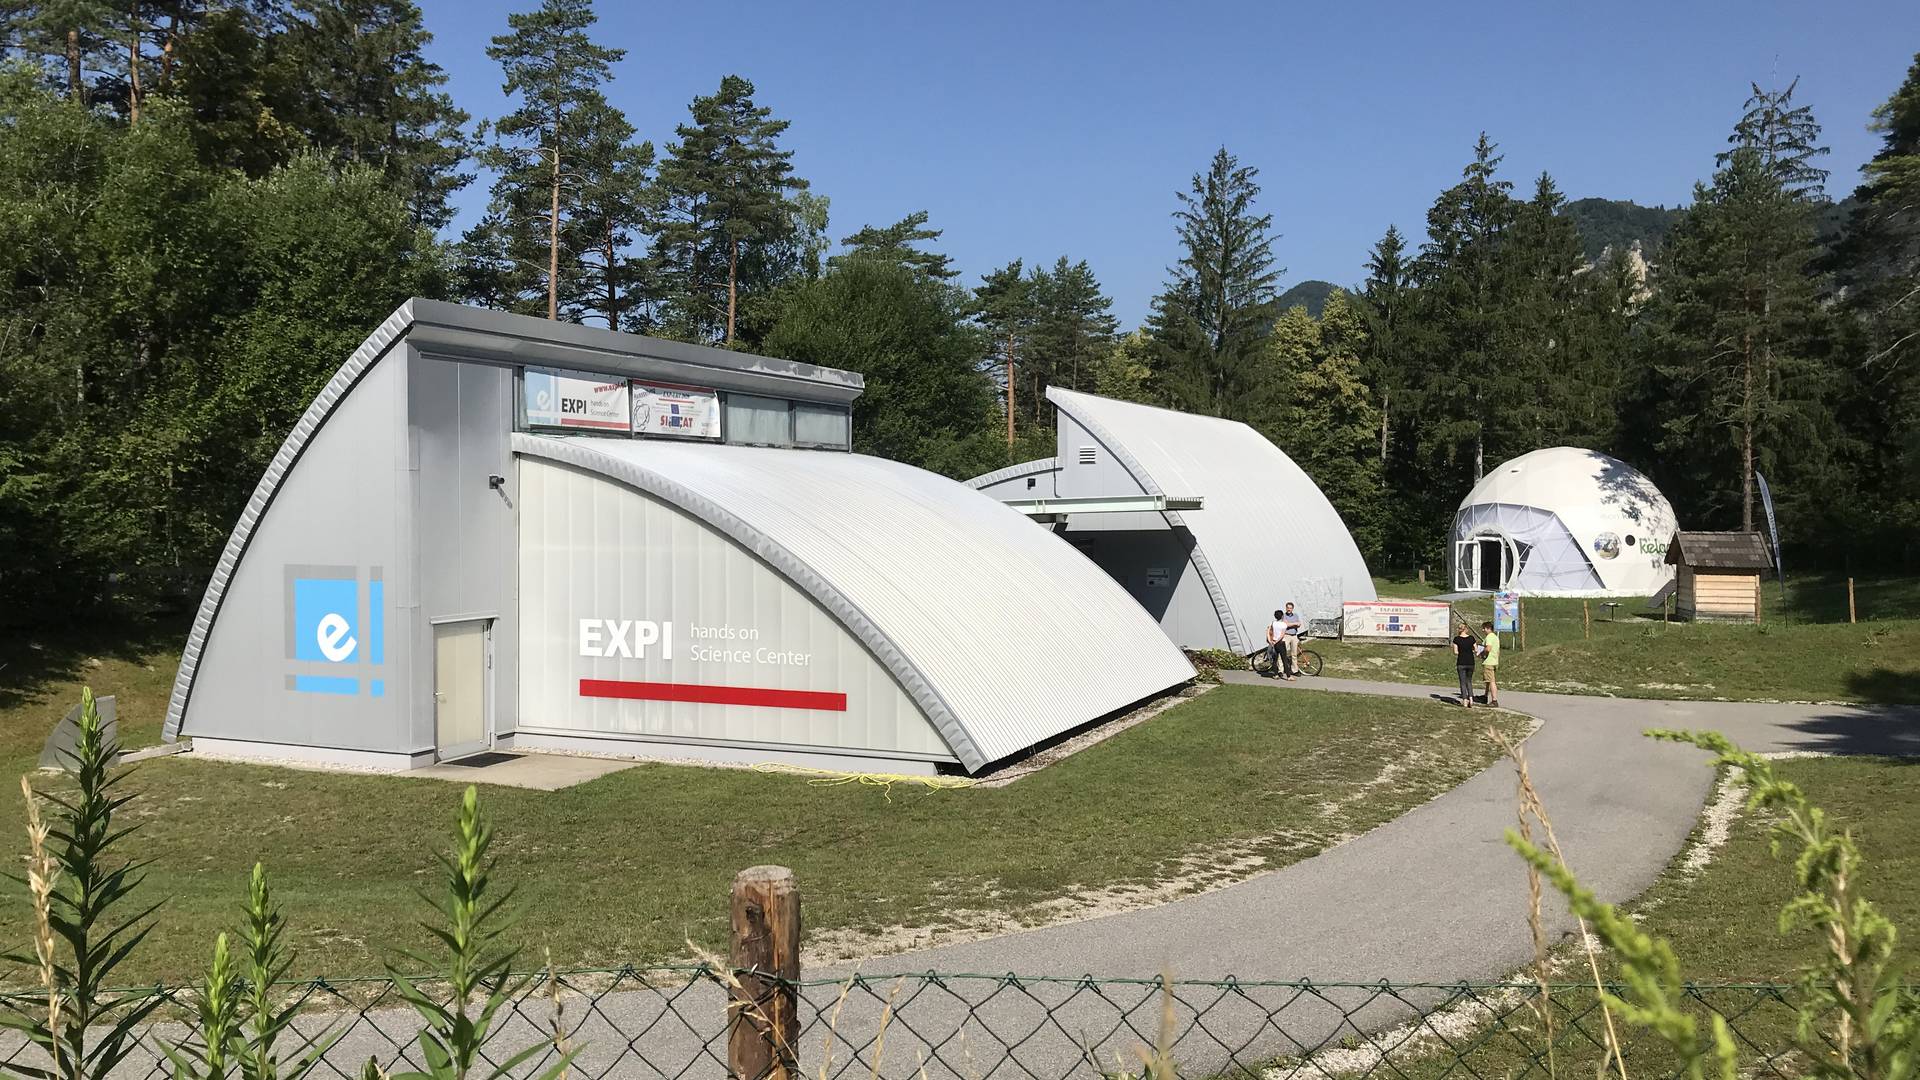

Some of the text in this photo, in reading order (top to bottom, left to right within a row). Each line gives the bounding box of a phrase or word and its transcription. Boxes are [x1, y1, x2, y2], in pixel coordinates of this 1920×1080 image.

[561, 398, 587, 414] EXPI
[1639, 538, 1671, 554] kela
[579, 618, 673, 660] EXPI
[690, 623, 759, 640] hands on
[690, 644, 811, 666] Science Center
